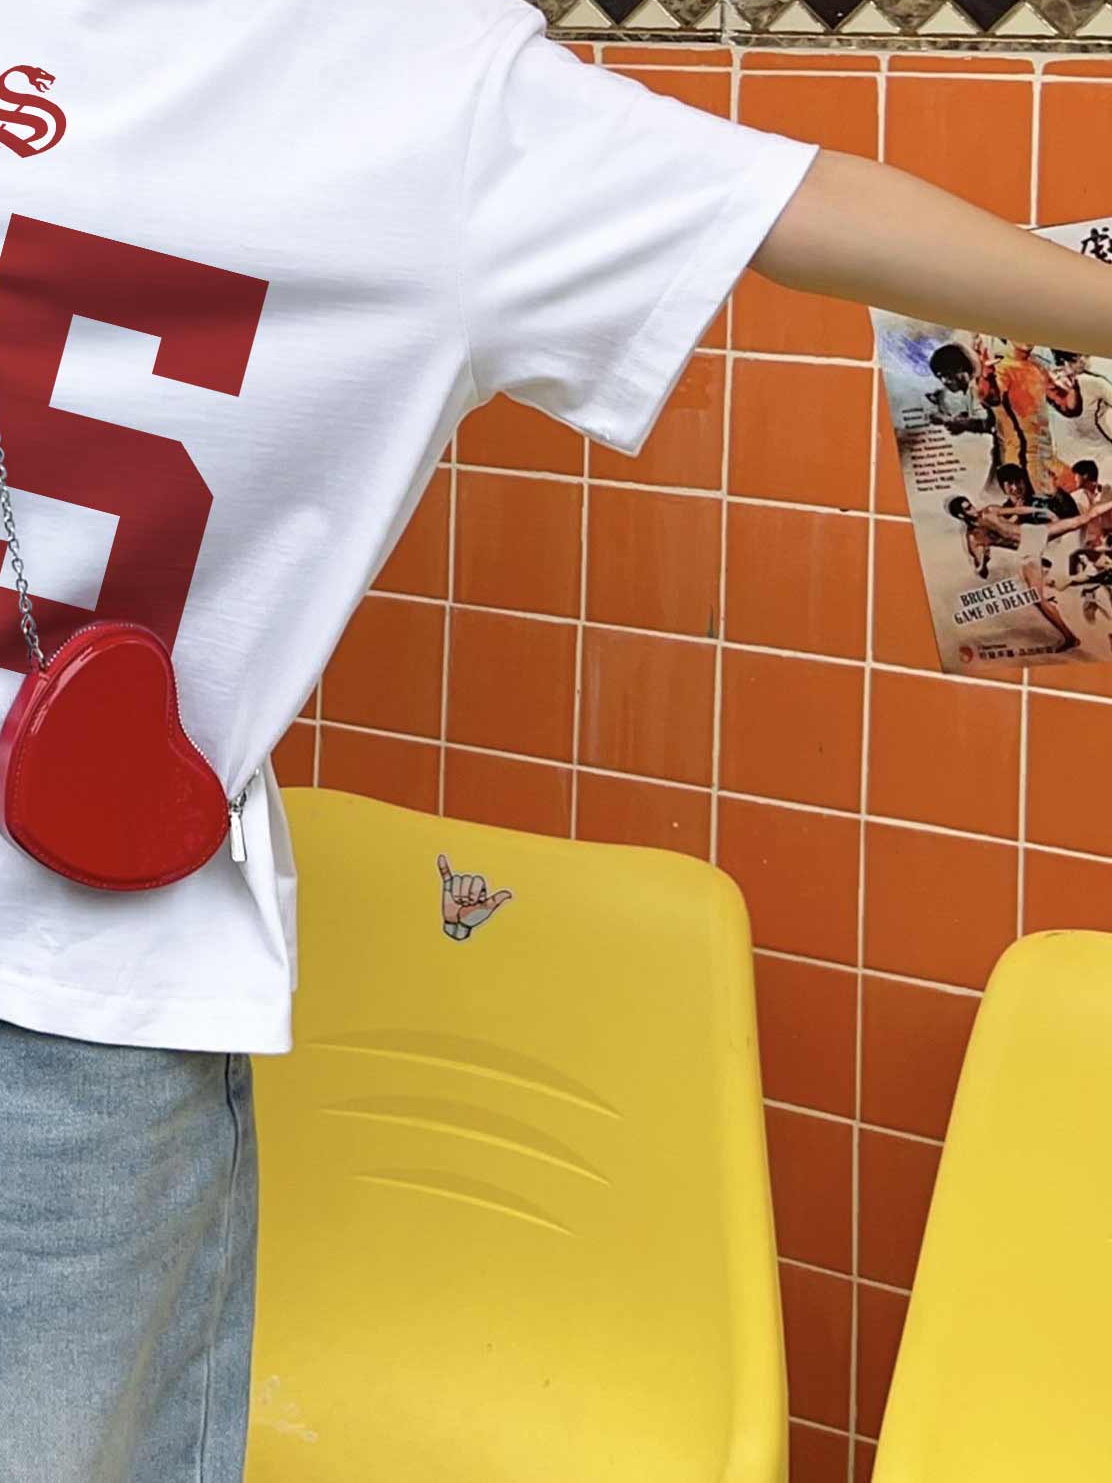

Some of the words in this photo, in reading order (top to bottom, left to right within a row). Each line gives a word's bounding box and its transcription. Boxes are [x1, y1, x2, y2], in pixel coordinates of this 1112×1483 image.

[954, 606, 984, 625] GAME
[985, 599, 1001, 615] OF
[1002, 588, 1040, 611] DEATH
[960, 586, 995, 607] BRUCE
[998, 580, 1017, 598] LEE
